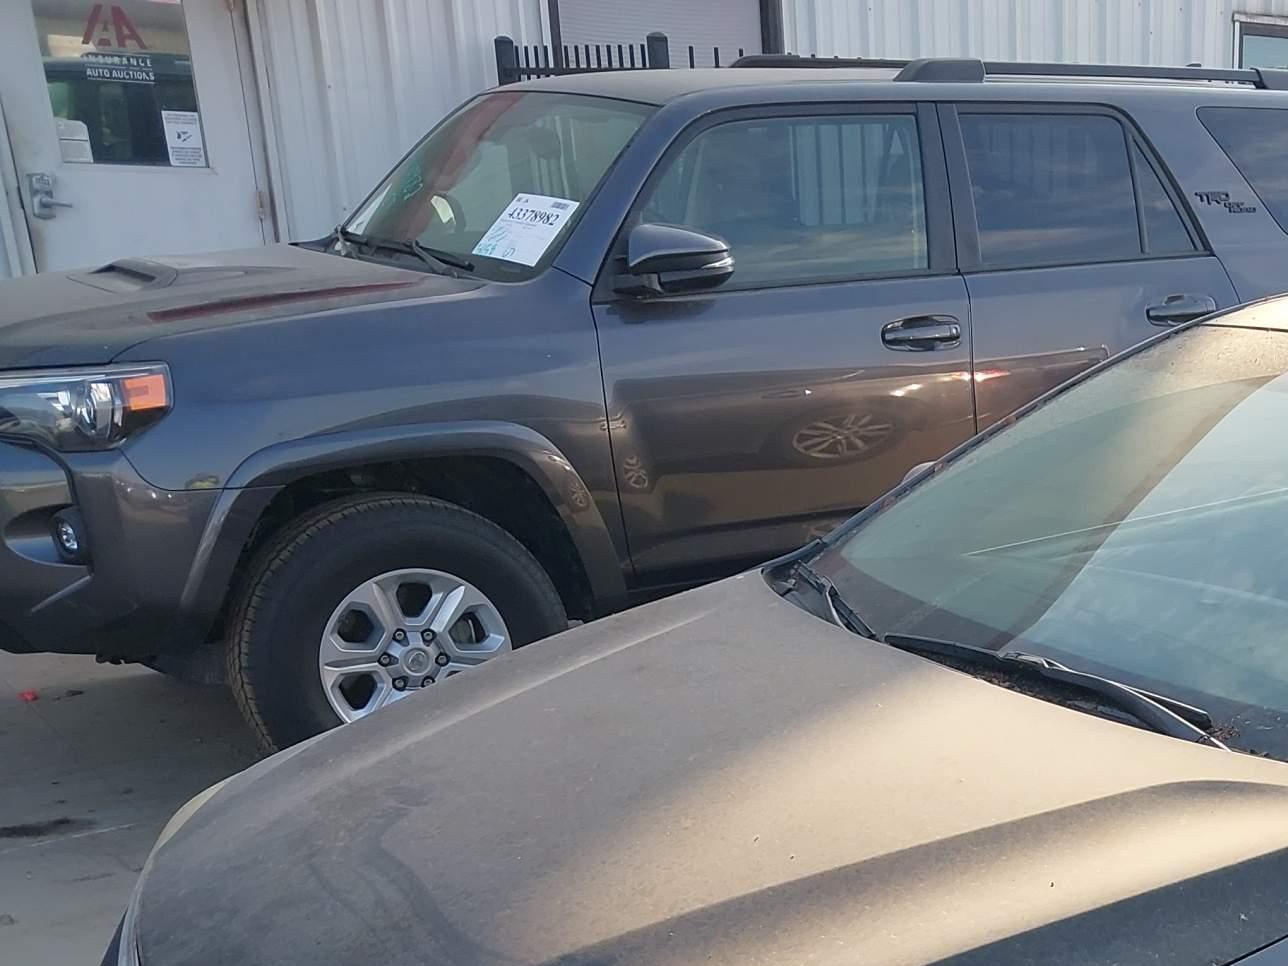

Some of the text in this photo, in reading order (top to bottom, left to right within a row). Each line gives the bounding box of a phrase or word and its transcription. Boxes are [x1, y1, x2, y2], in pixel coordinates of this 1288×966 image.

[81, 55, 153, 67] INSURANCE
[86, 67, 155, 80] AUTO AUCTIONS
[508, 208, 559, 226] 43378982
